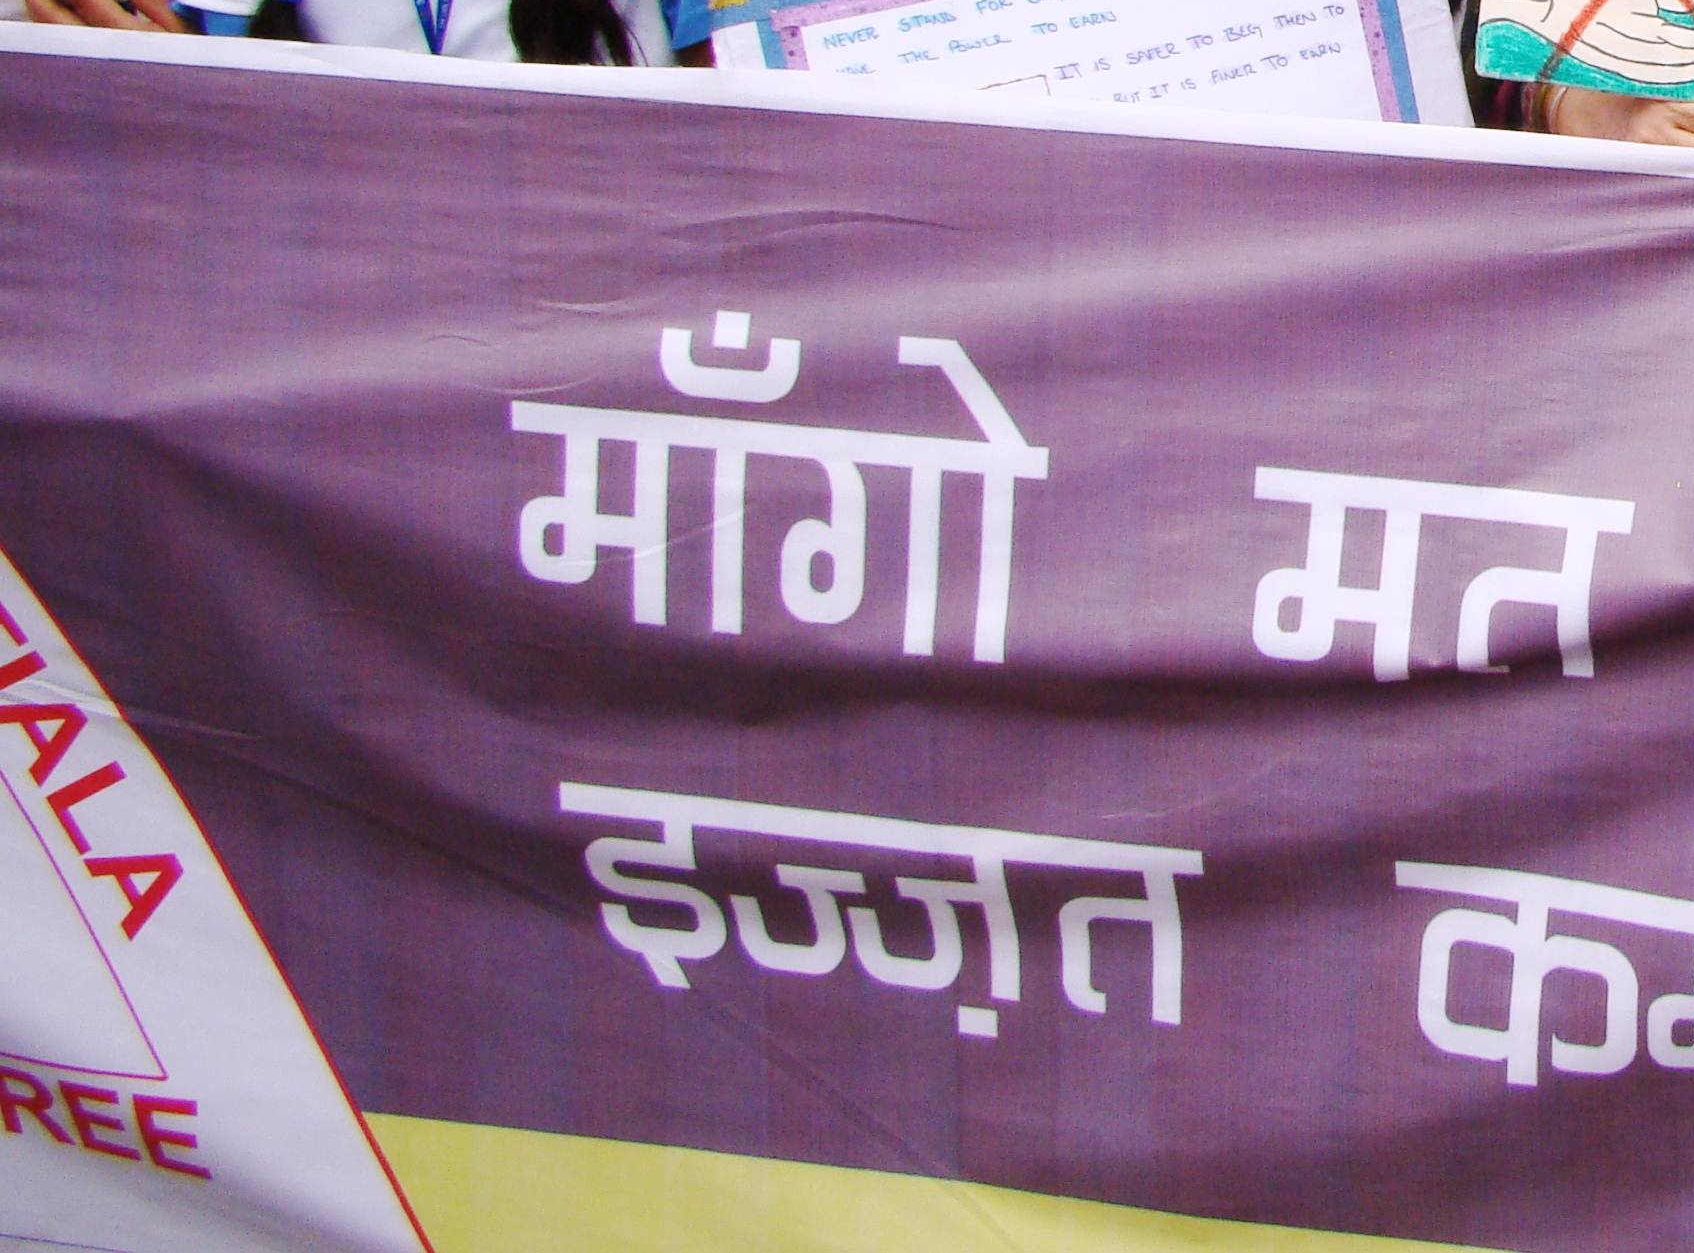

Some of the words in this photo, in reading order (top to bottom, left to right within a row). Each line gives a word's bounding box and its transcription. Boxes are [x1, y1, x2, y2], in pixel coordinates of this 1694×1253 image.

[822, 25, 881, 50] NEVER
[897, 51, 940, 65] THE
[1031, 21, 1059, 36] TO
[1068, 10, 1118, 30] EARN
[1053, 63, 1083, 81] IT
[1093, 57, 1112, 72] IS
[1125, 41, 1181, 65] SAFER
[1186, 34, 1215, 51] TO
[1223, 23, 1264, 43] BEG
[1273, 9, 1318, 29] THEN
[1322, 4, 1346, 17] TO
[1149, 83, 1170, 99] IT
[1180, 77, 1198, 91] IS
[1260, 54, 1289, 72] TO
[1299, 41, 1343, 61] EARN
[1251, 465, 1637, 684] मत
